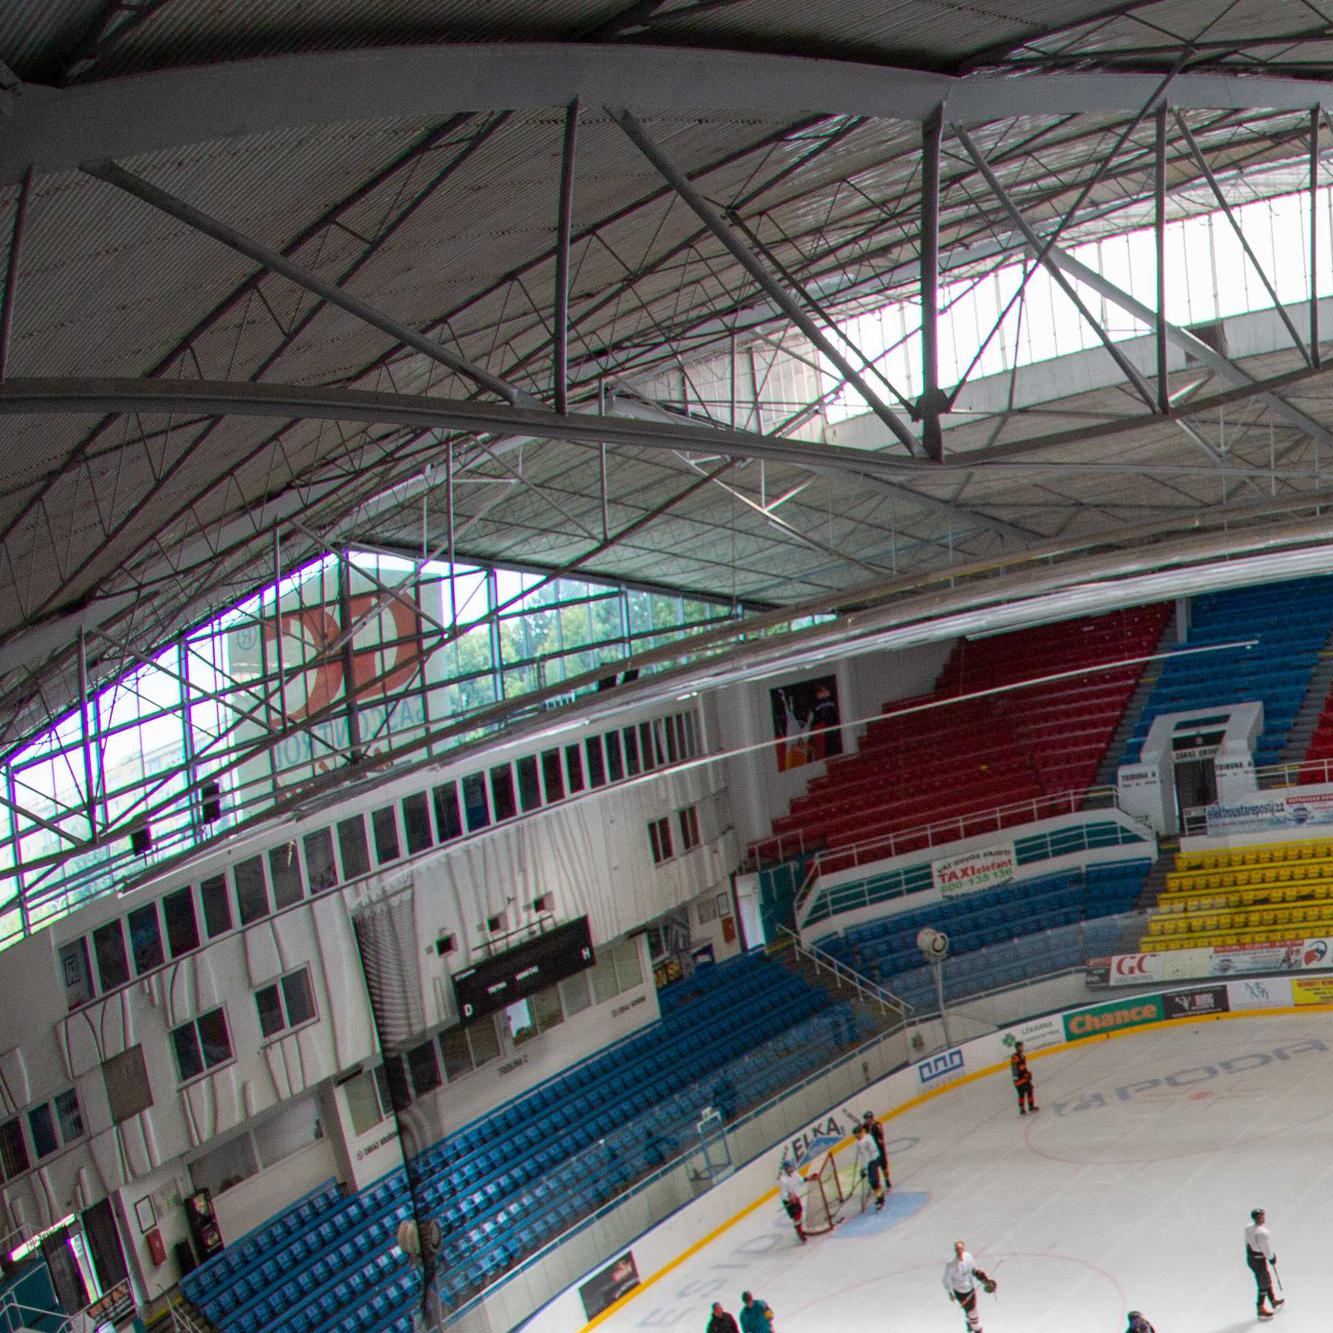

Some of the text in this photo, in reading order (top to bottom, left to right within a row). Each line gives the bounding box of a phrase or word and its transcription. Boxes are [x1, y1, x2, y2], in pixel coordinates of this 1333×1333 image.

[582, 946, 591, 960] H
[1116, 954, 1156, 976] GC
[463, 1004, 473, 1017] D
[1068, 1004, 1158, 1035] Chance
